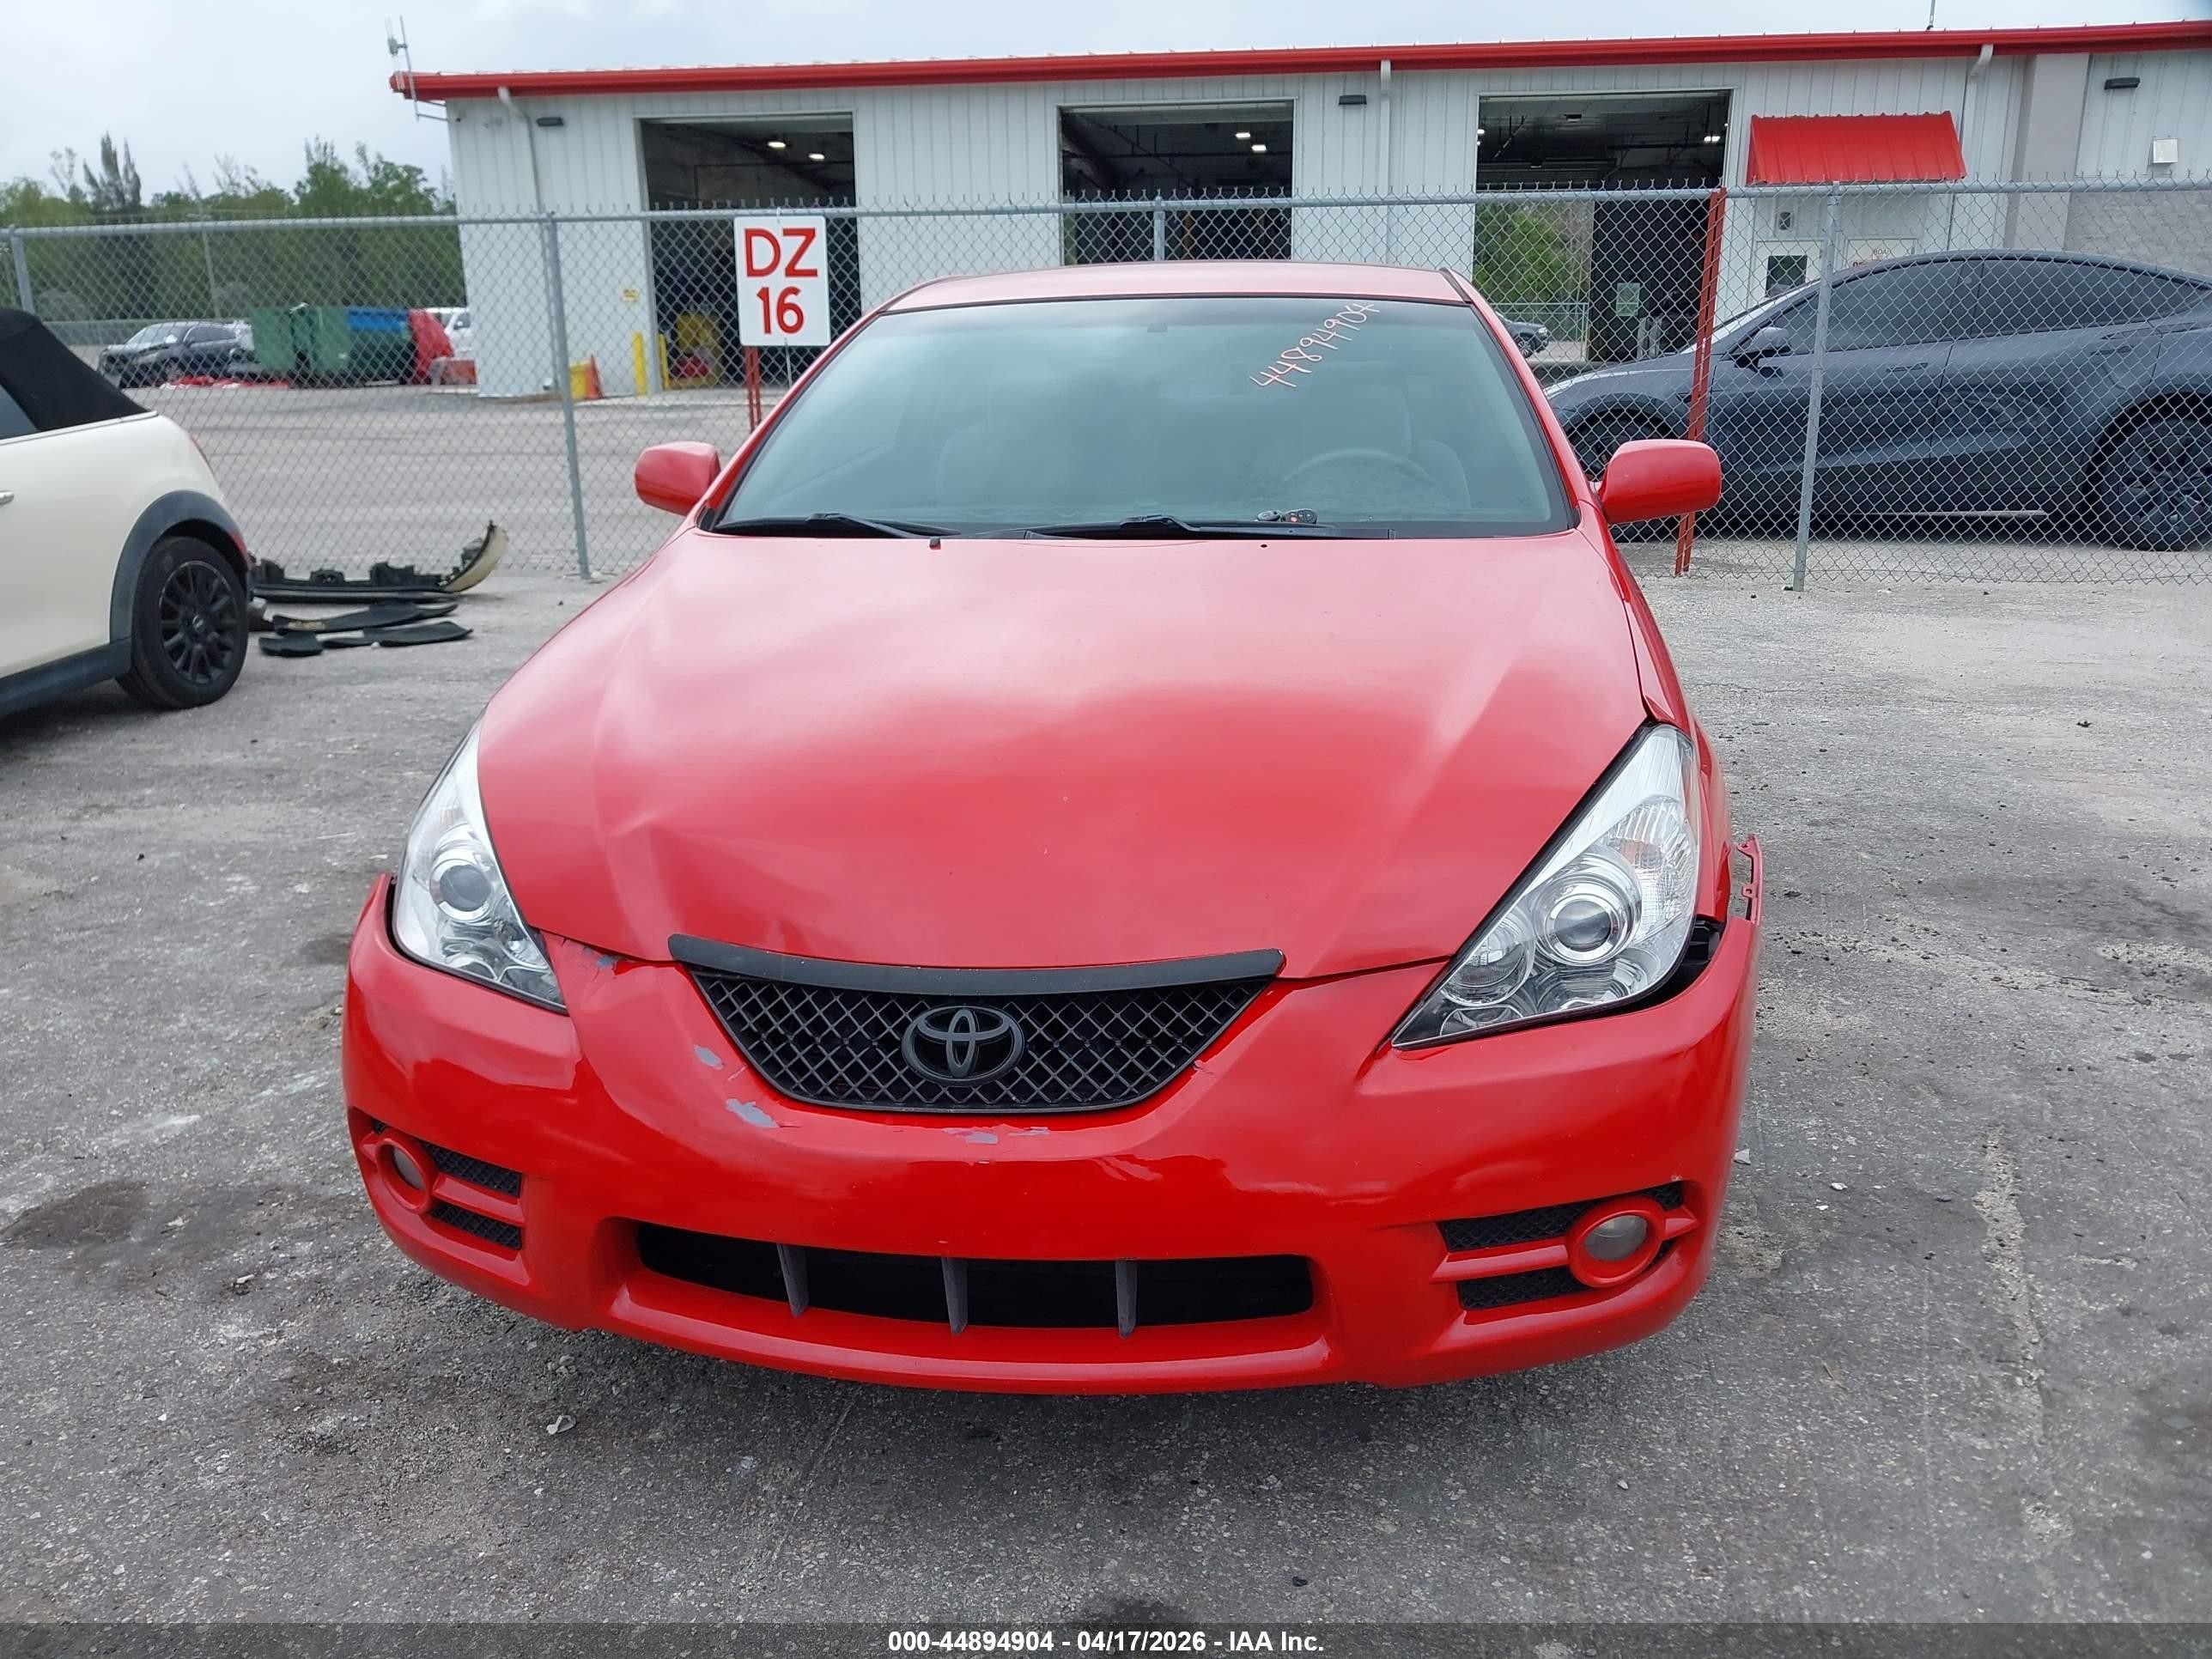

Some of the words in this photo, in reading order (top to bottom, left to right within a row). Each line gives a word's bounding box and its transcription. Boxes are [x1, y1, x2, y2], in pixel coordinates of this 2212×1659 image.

[744, 228, 817, 277] DZ
[757, 286, 804, 334] 16
[1249, 303, 1380, 388] 44894904
